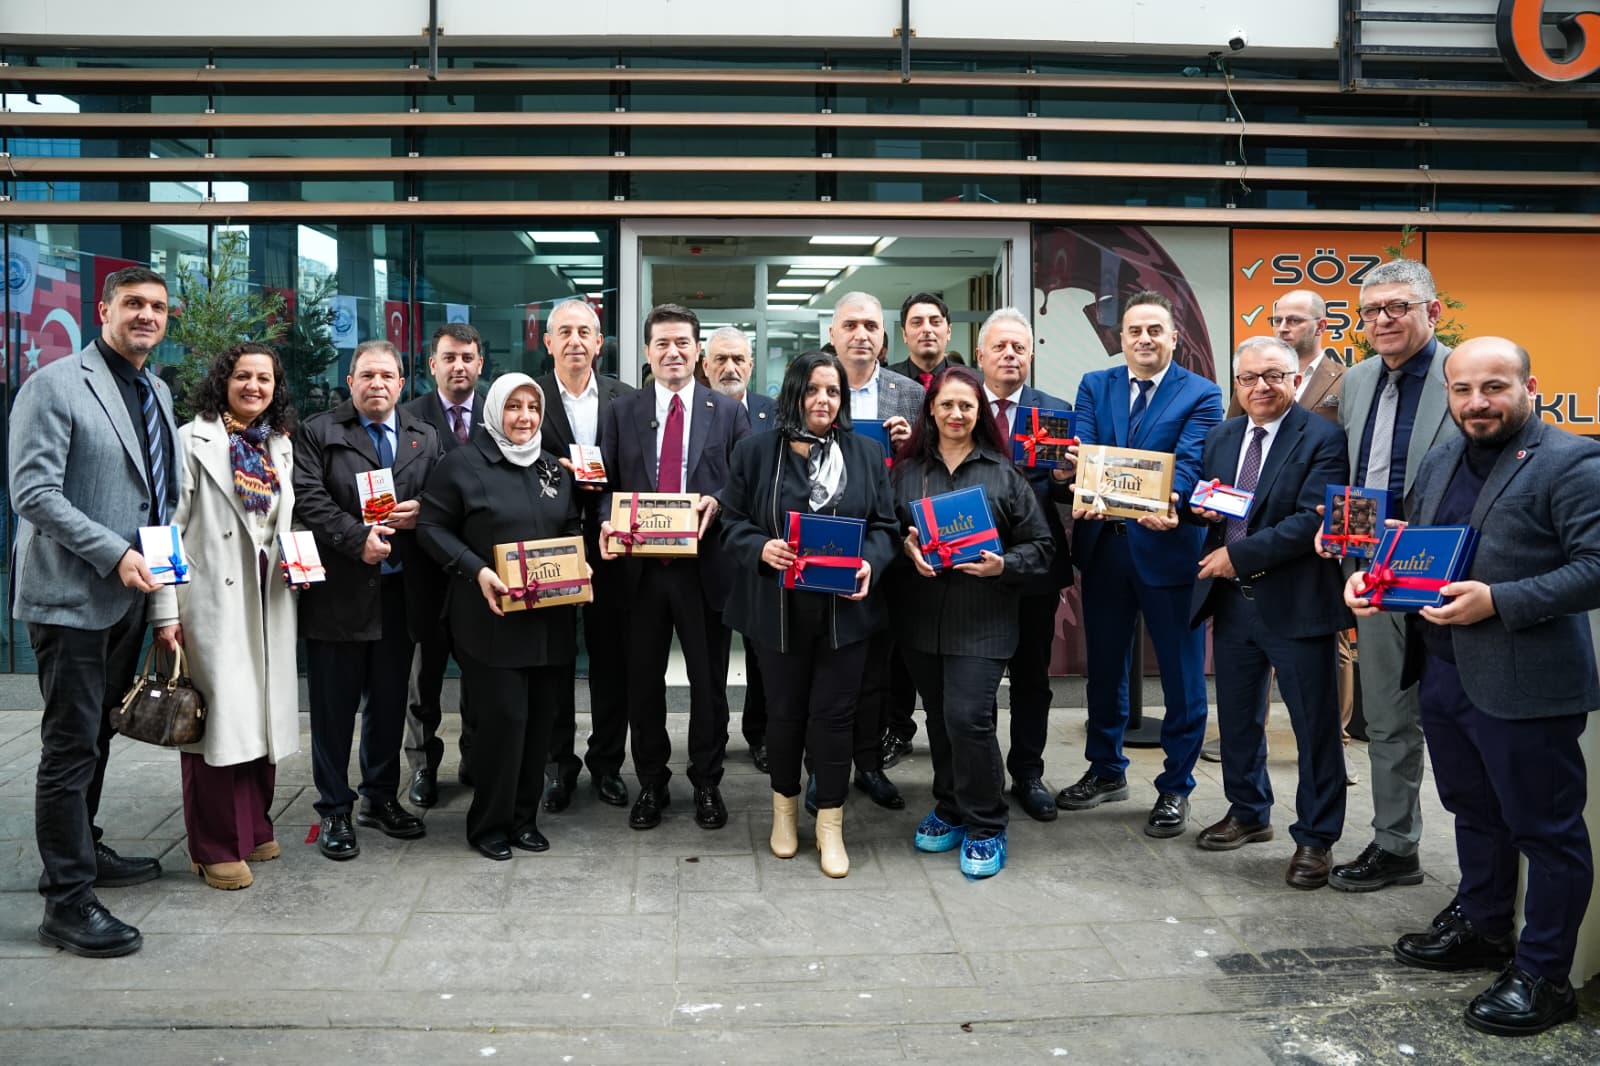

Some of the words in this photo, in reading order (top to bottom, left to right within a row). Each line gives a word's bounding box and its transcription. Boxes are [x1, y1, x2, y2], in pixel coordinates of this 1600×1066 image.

[1272, 248, 1381, 286] SÖZ
[1533, 387, 1600, 424] KL
[639, 515, 671, 529] zuluf
[937, 514, 975, 537] zuluf
[528, 562, 561, 581] zuluf
[1390, 555, 1434, 571] zuluf
